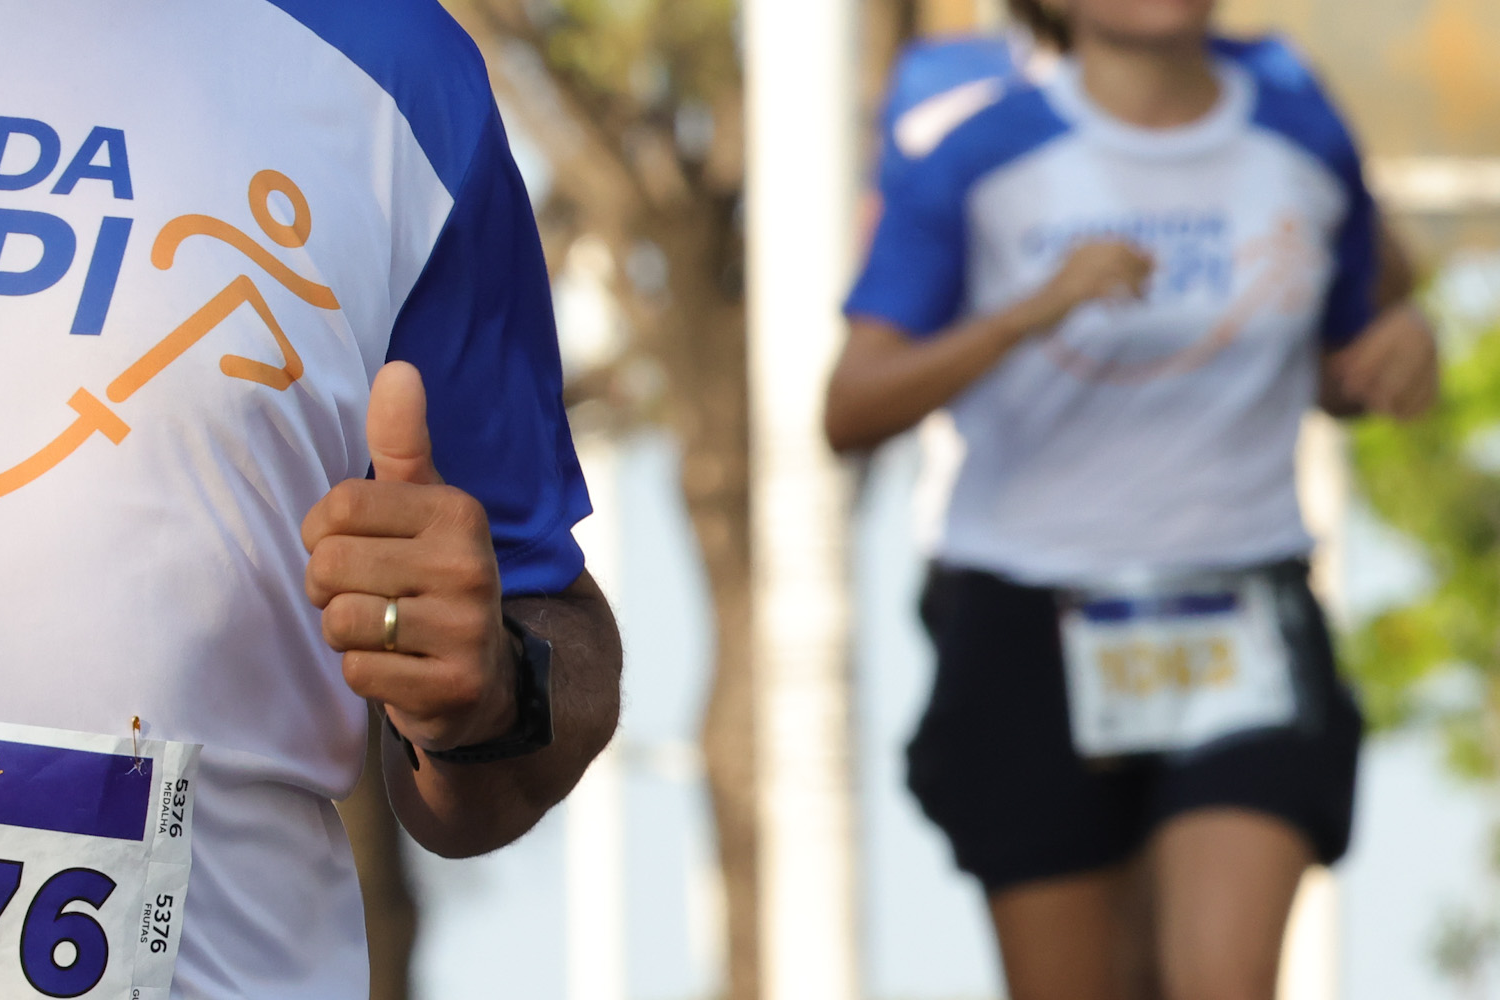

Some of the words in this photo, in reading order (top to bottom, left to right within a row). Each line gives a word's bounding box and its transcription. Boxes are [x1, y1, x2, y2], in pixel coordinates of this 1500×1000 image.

[158, 781, 173, 834] MEDALHA
[169, 778, 188, 838] 5376
[140, 903, 153, 943] FRUTAS
[150, 893, 174, 954] 5376
